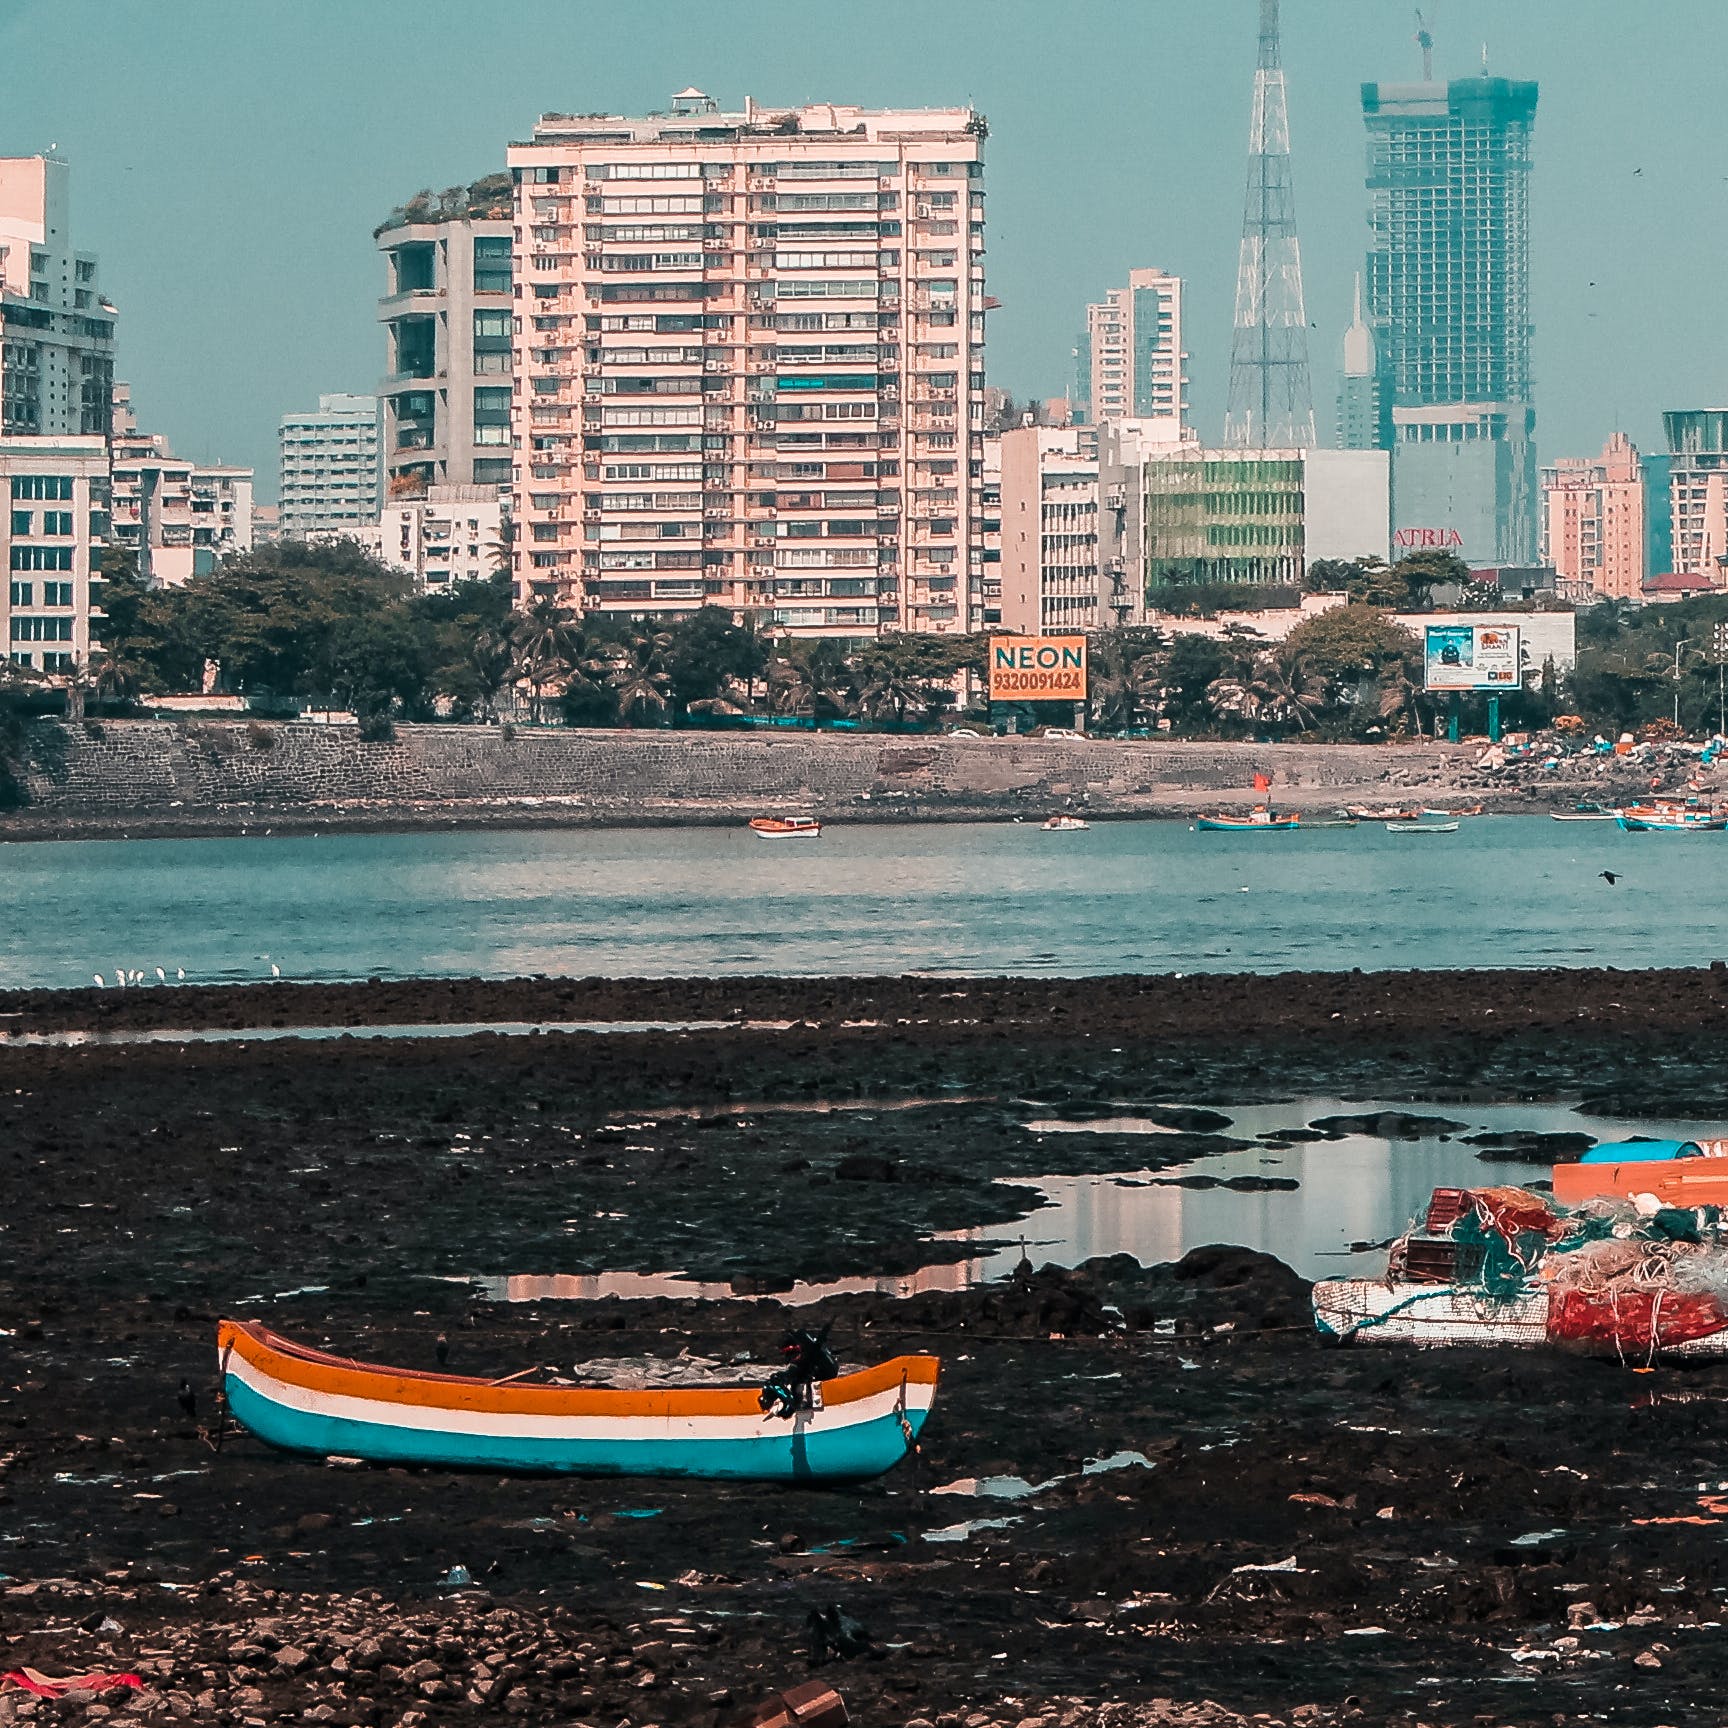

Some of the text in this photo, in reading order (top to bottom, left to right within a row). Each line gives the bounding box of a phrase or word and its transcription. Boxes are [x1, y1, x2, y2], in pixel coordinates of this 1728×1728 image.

[1393, 528, 1464, 546] ATRIA
[996, 647, 1082, 669] NEON
[993, 672, 1081, 690] 9320091424
